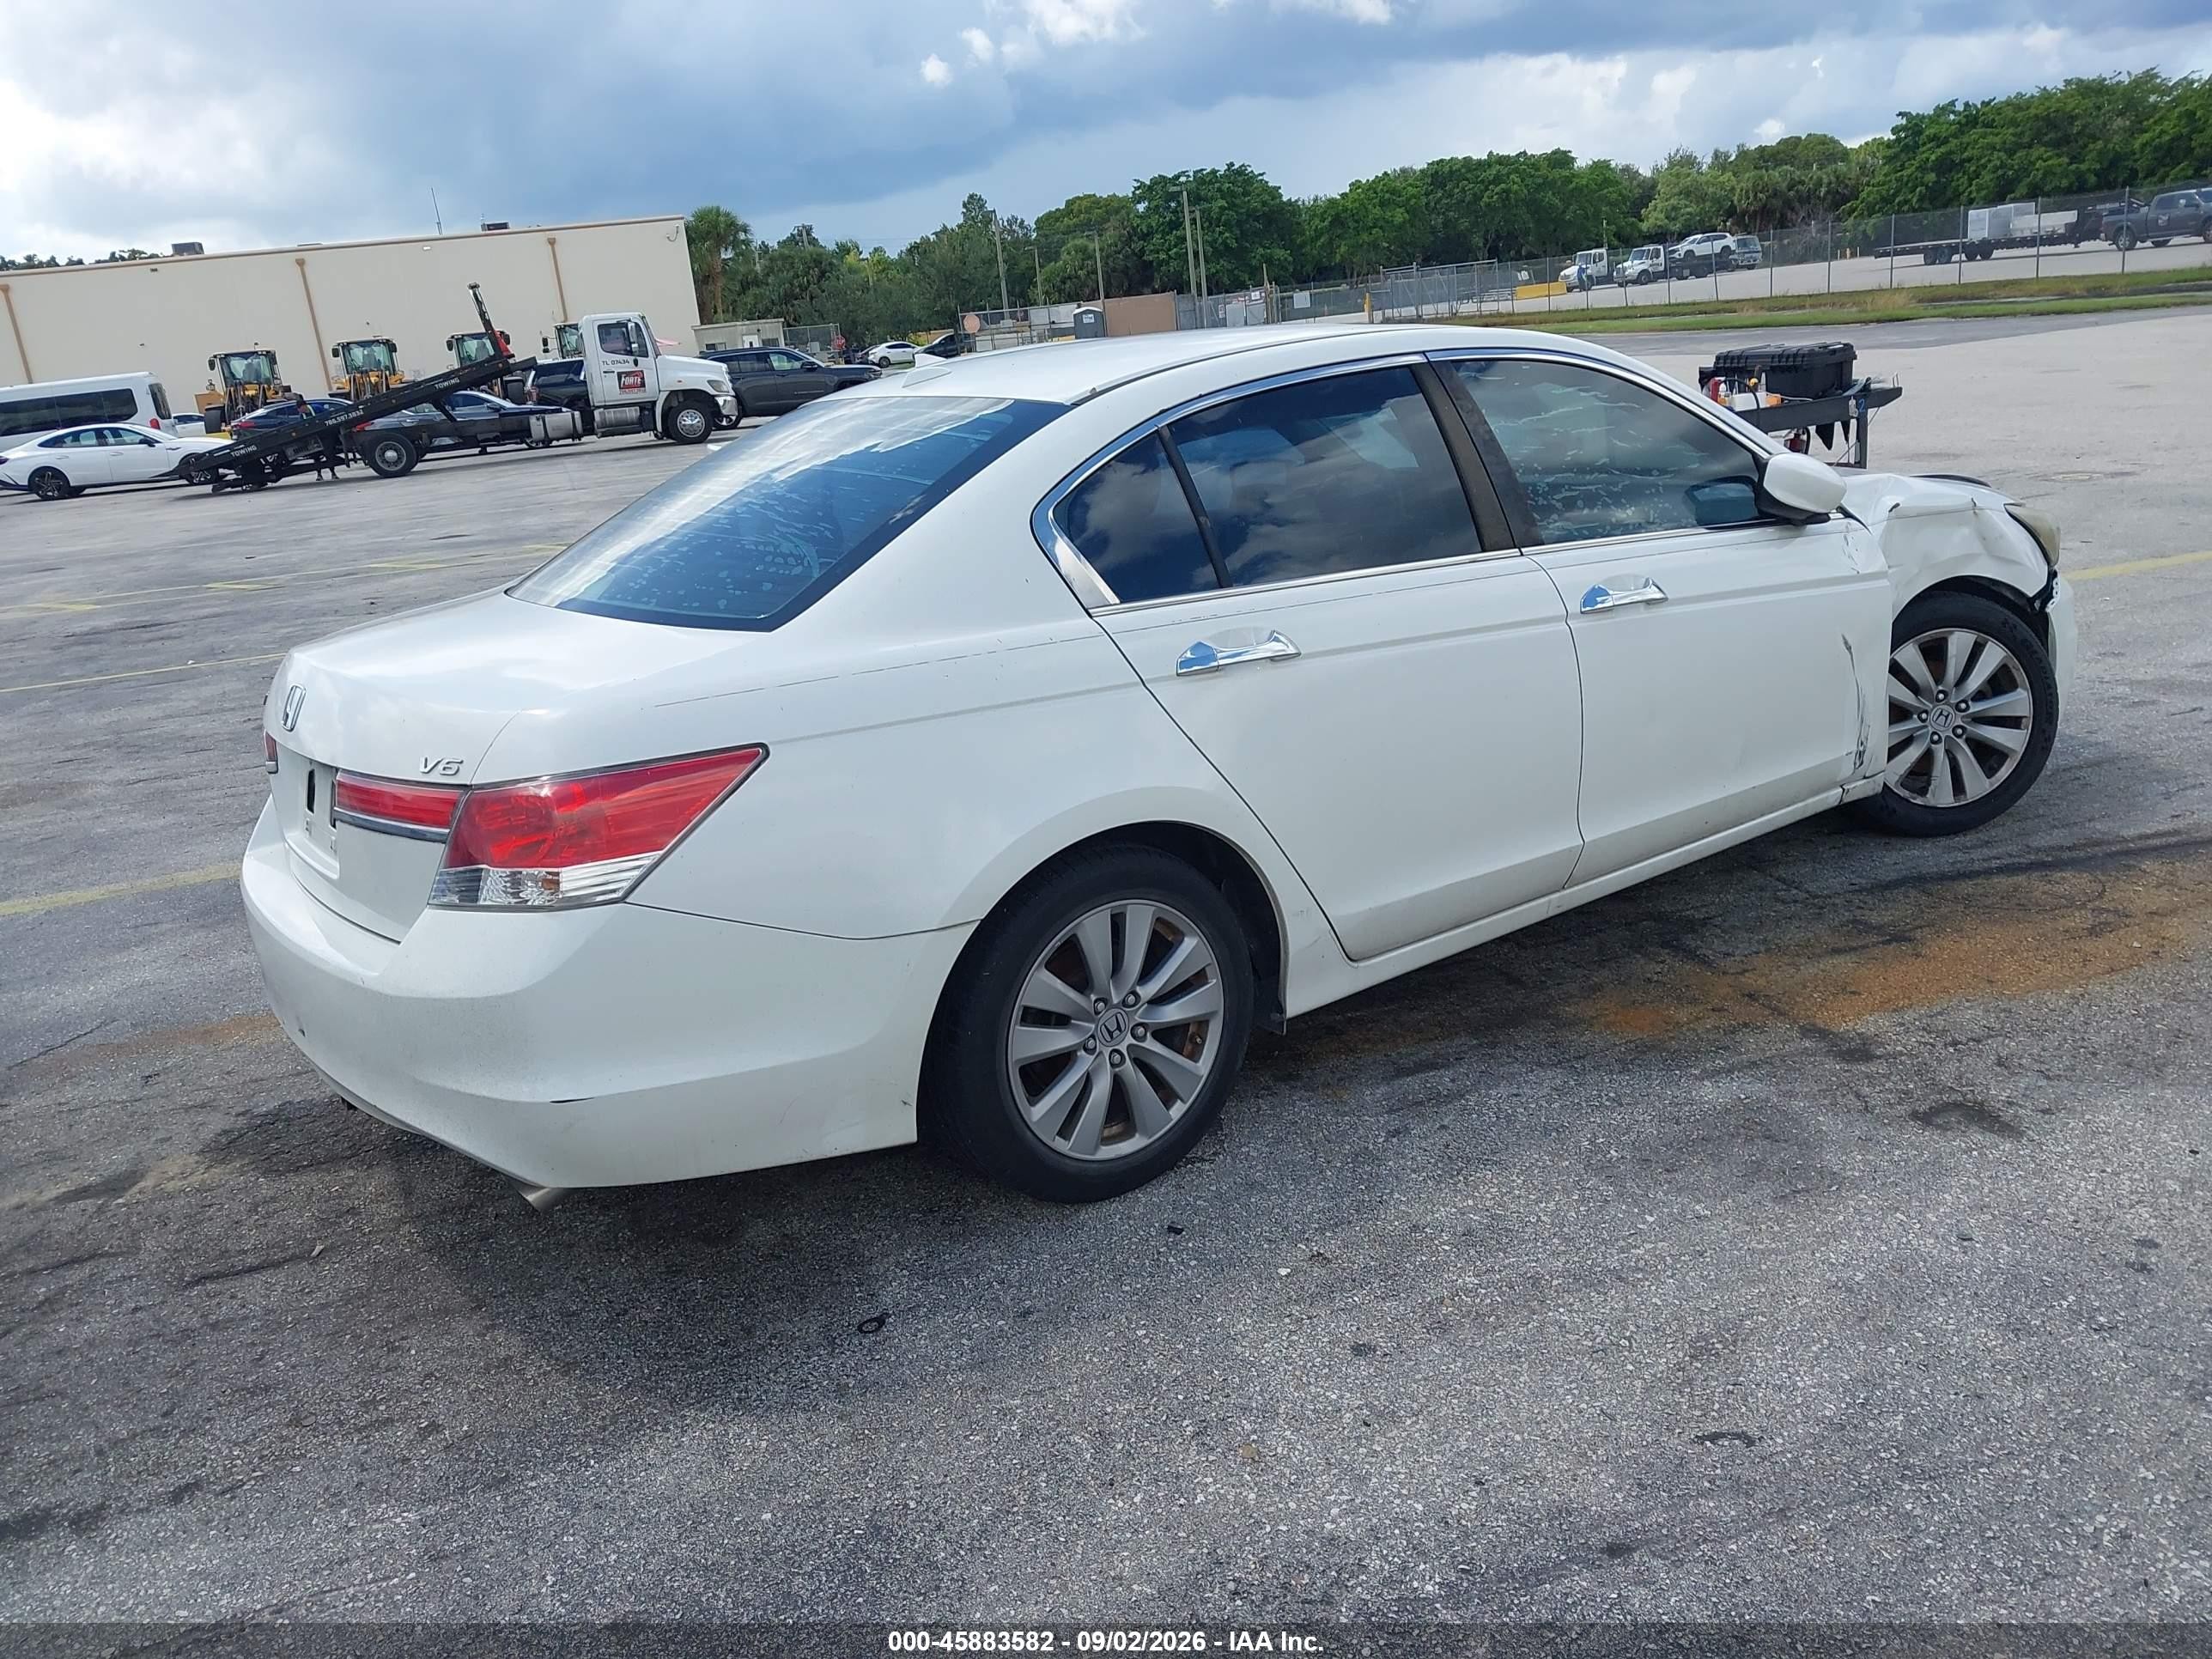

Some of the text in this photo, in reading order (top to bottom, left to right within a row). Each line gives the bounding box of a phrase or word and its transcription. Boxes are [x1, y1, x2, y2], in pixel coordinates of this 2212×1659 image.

[434, 378, 459, 389] TOWING
[621, 374, 641, 387] FORTE
[1858, 398, 1866, 413] 2
[230, 445, 257, 457] TOWING
[420, 756, 464, 776] V6
